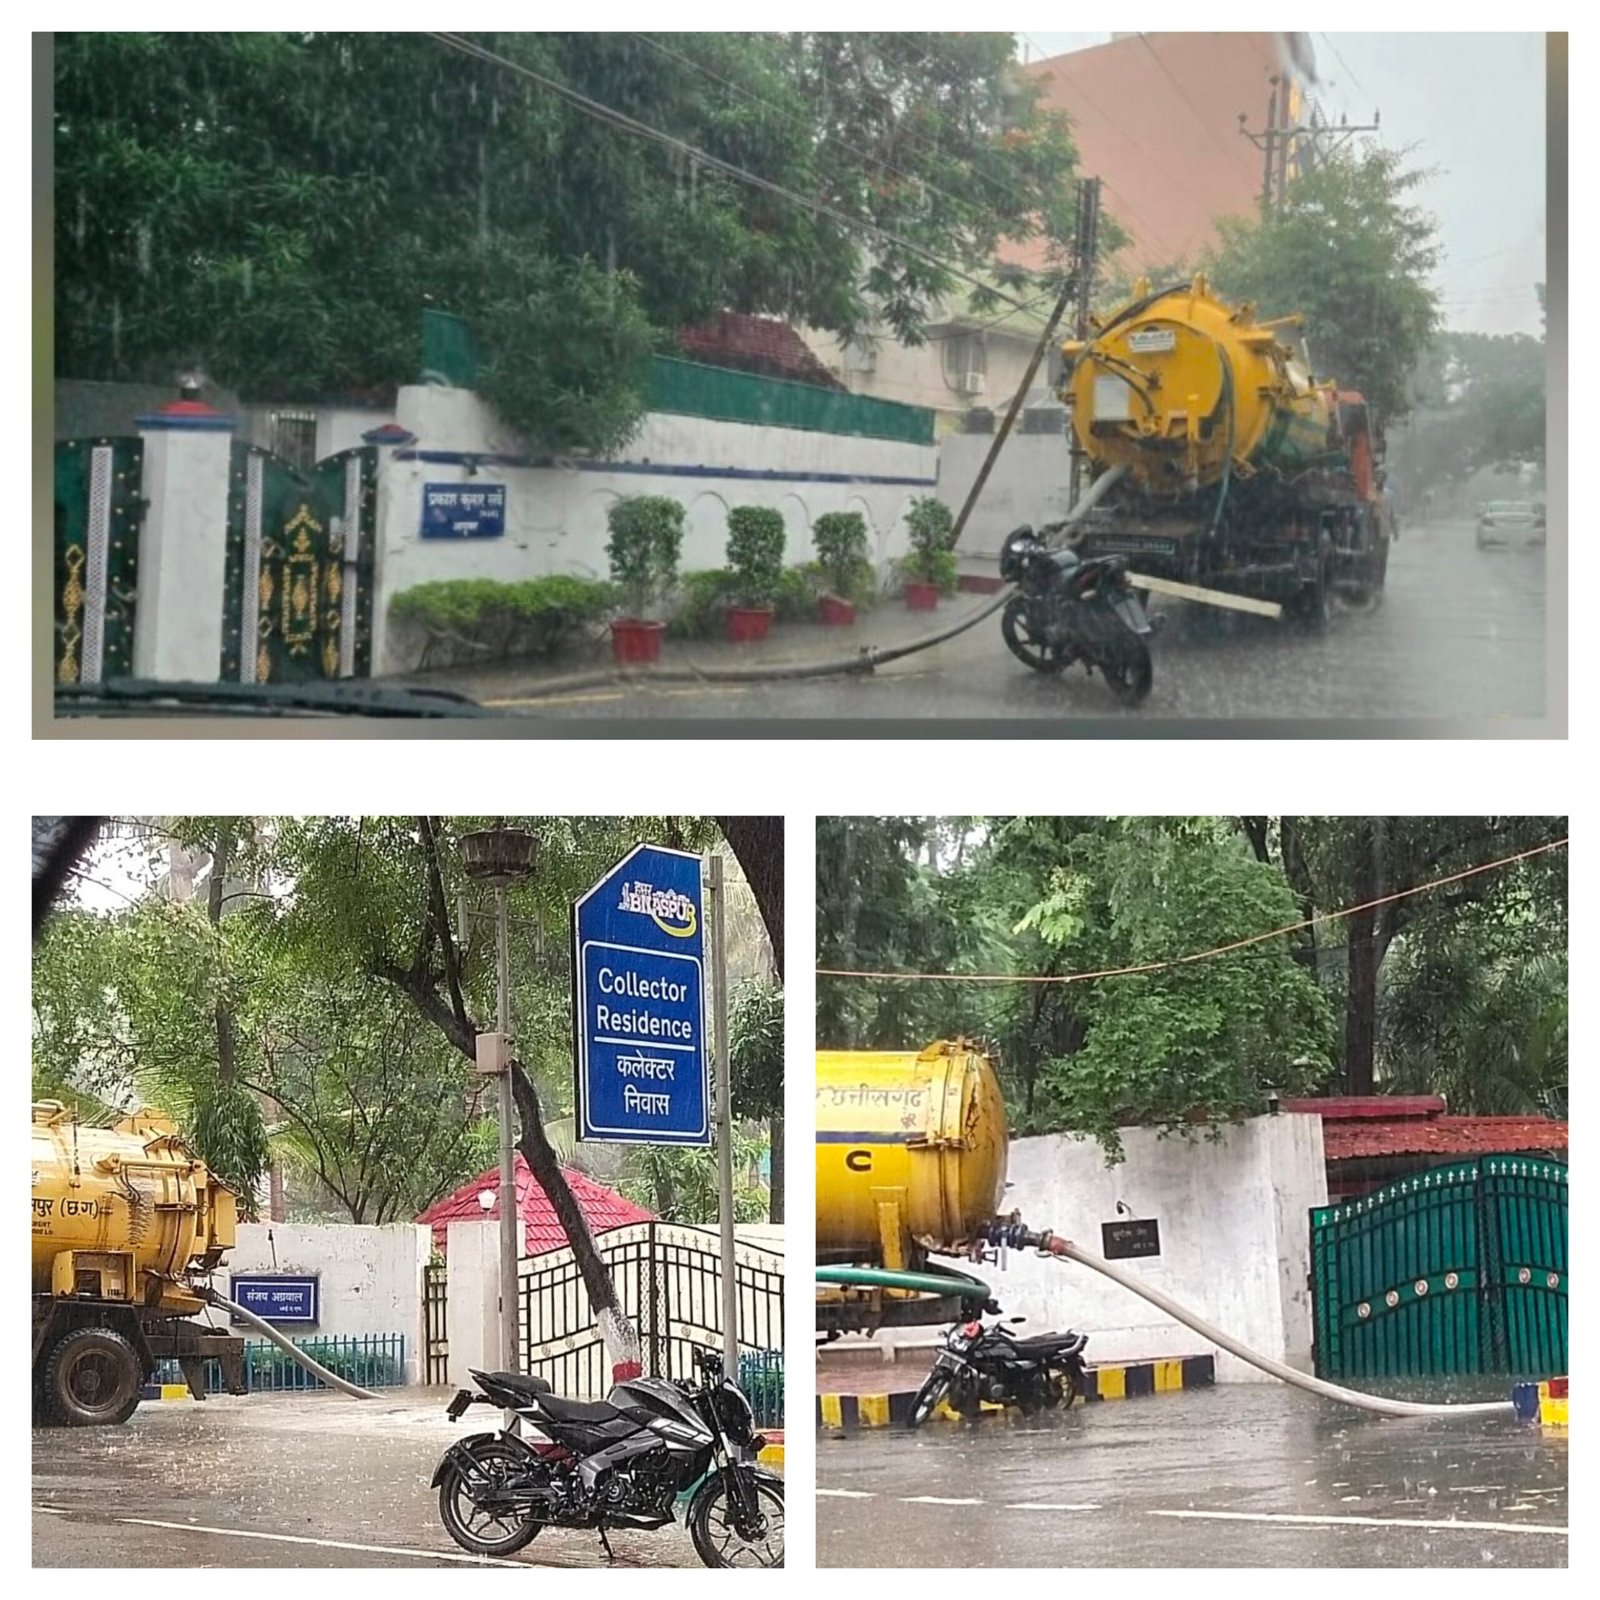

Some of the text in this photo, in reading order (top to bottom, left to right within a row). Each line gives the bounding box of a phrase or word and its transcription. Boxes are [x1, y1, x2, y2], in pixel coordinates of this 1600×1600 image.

[598, 967, 687, 1002] Collector
[596, 1005, 692, 1039] Residence
[616, 1049, 675, 1081] कलेक्टर
[623, 1084, 670, 1116] निवास
[845, 1150, 872, 1172] C
[246, 1288, 303, 1303] संजय अग्रवाल
